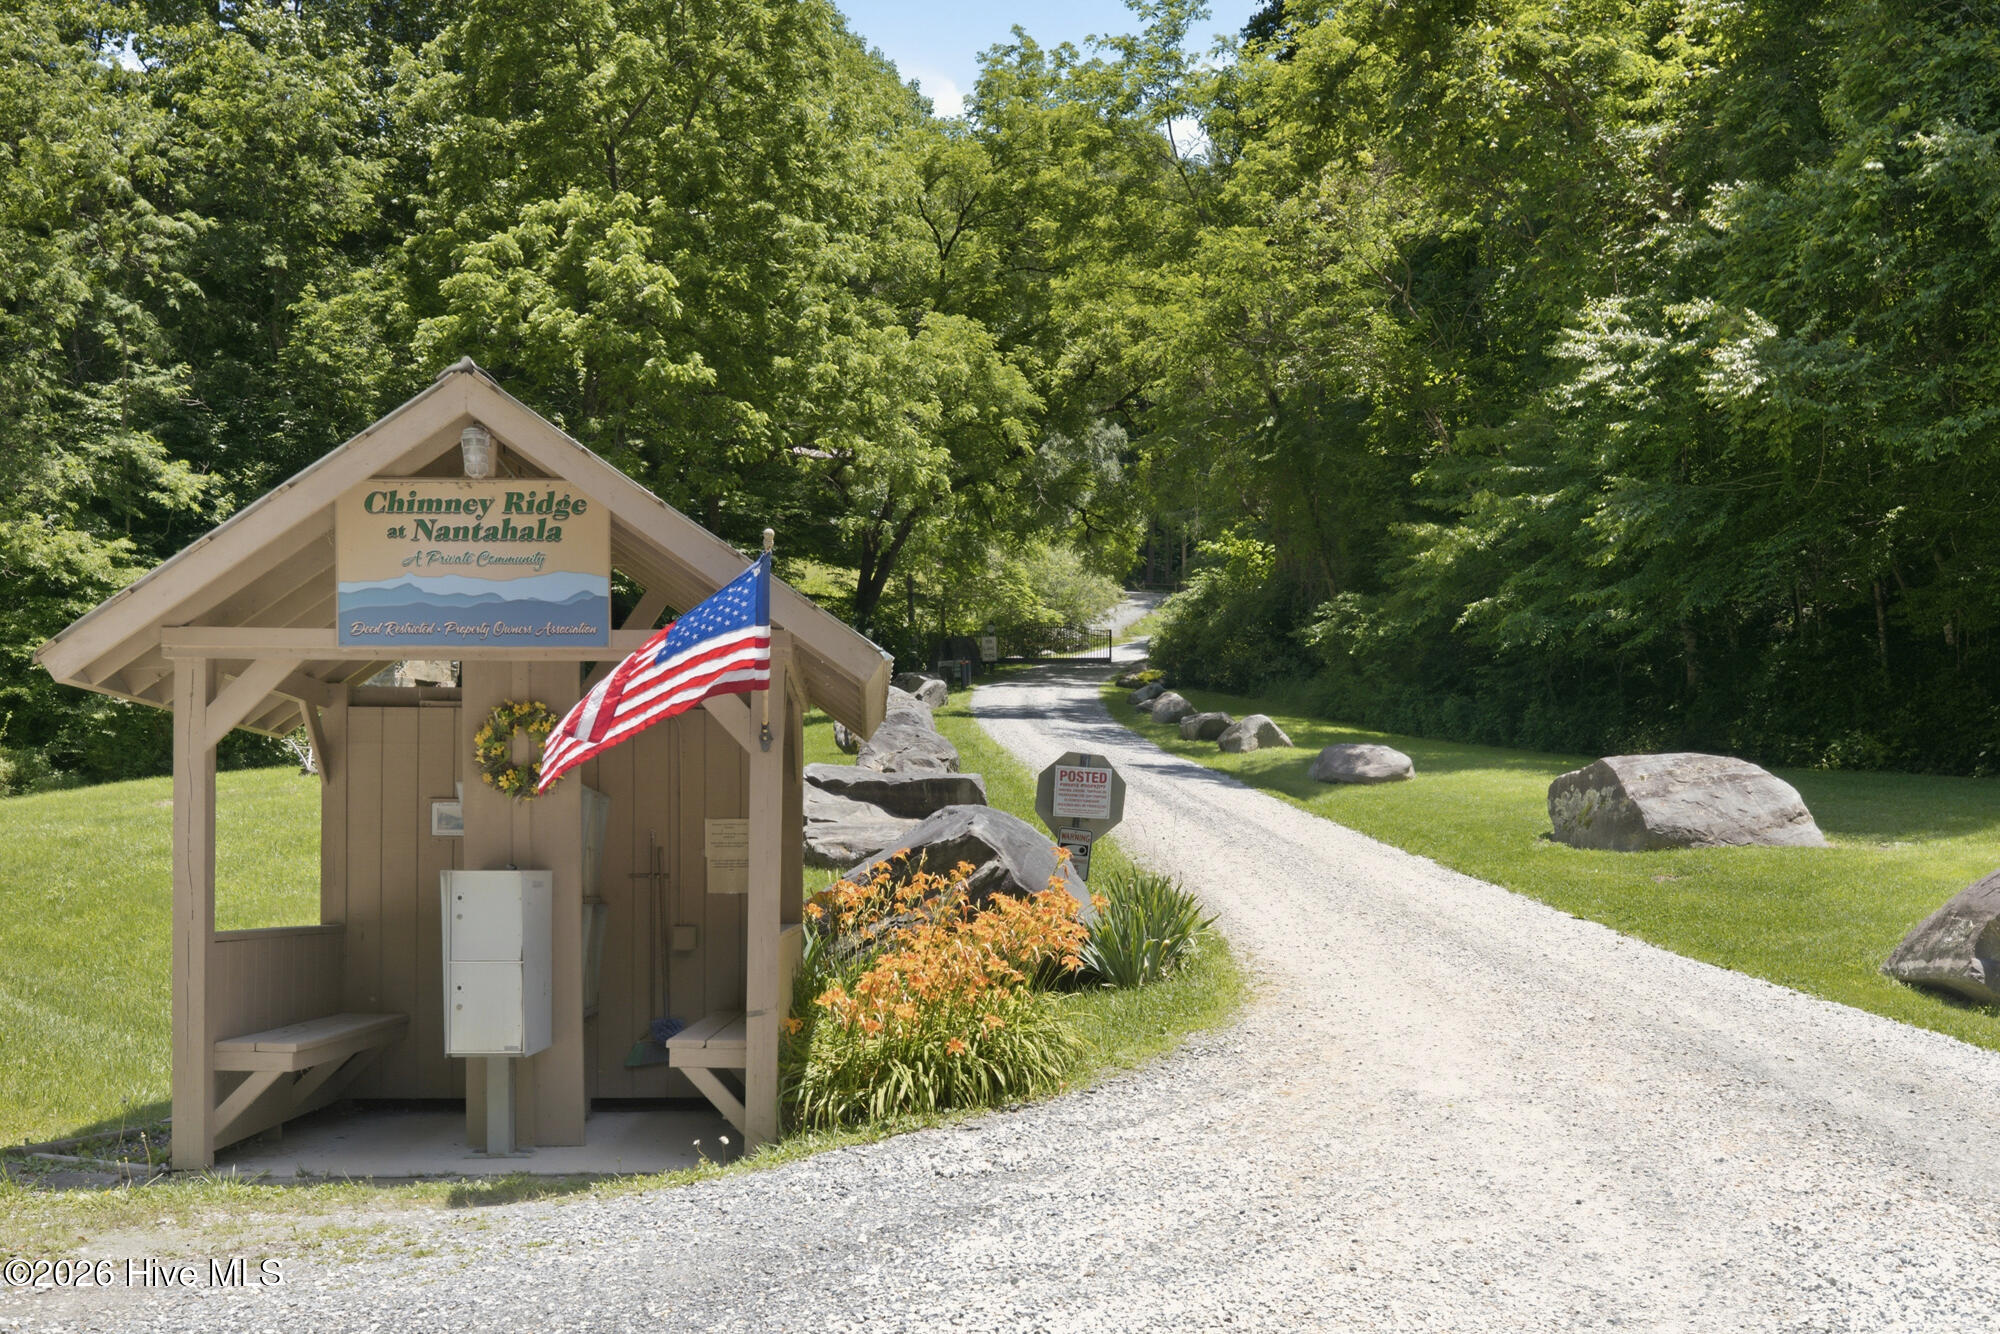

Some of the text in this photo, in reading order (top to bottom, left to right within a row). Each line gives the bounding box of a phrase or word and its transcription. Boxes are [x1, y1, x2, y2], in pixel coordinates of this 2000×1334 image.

[364, 490, 588, 520] Chimney Ridge
[386, 517, 563, 543] at Nantahala
[401, 550, 547, 572] A Private Community
[351, 620, 597, 640] Deed Restricted Property Owners Association
[1060, 770, 1107, 784] POSTED
[1061, 832, 1090, 842] WARNING
